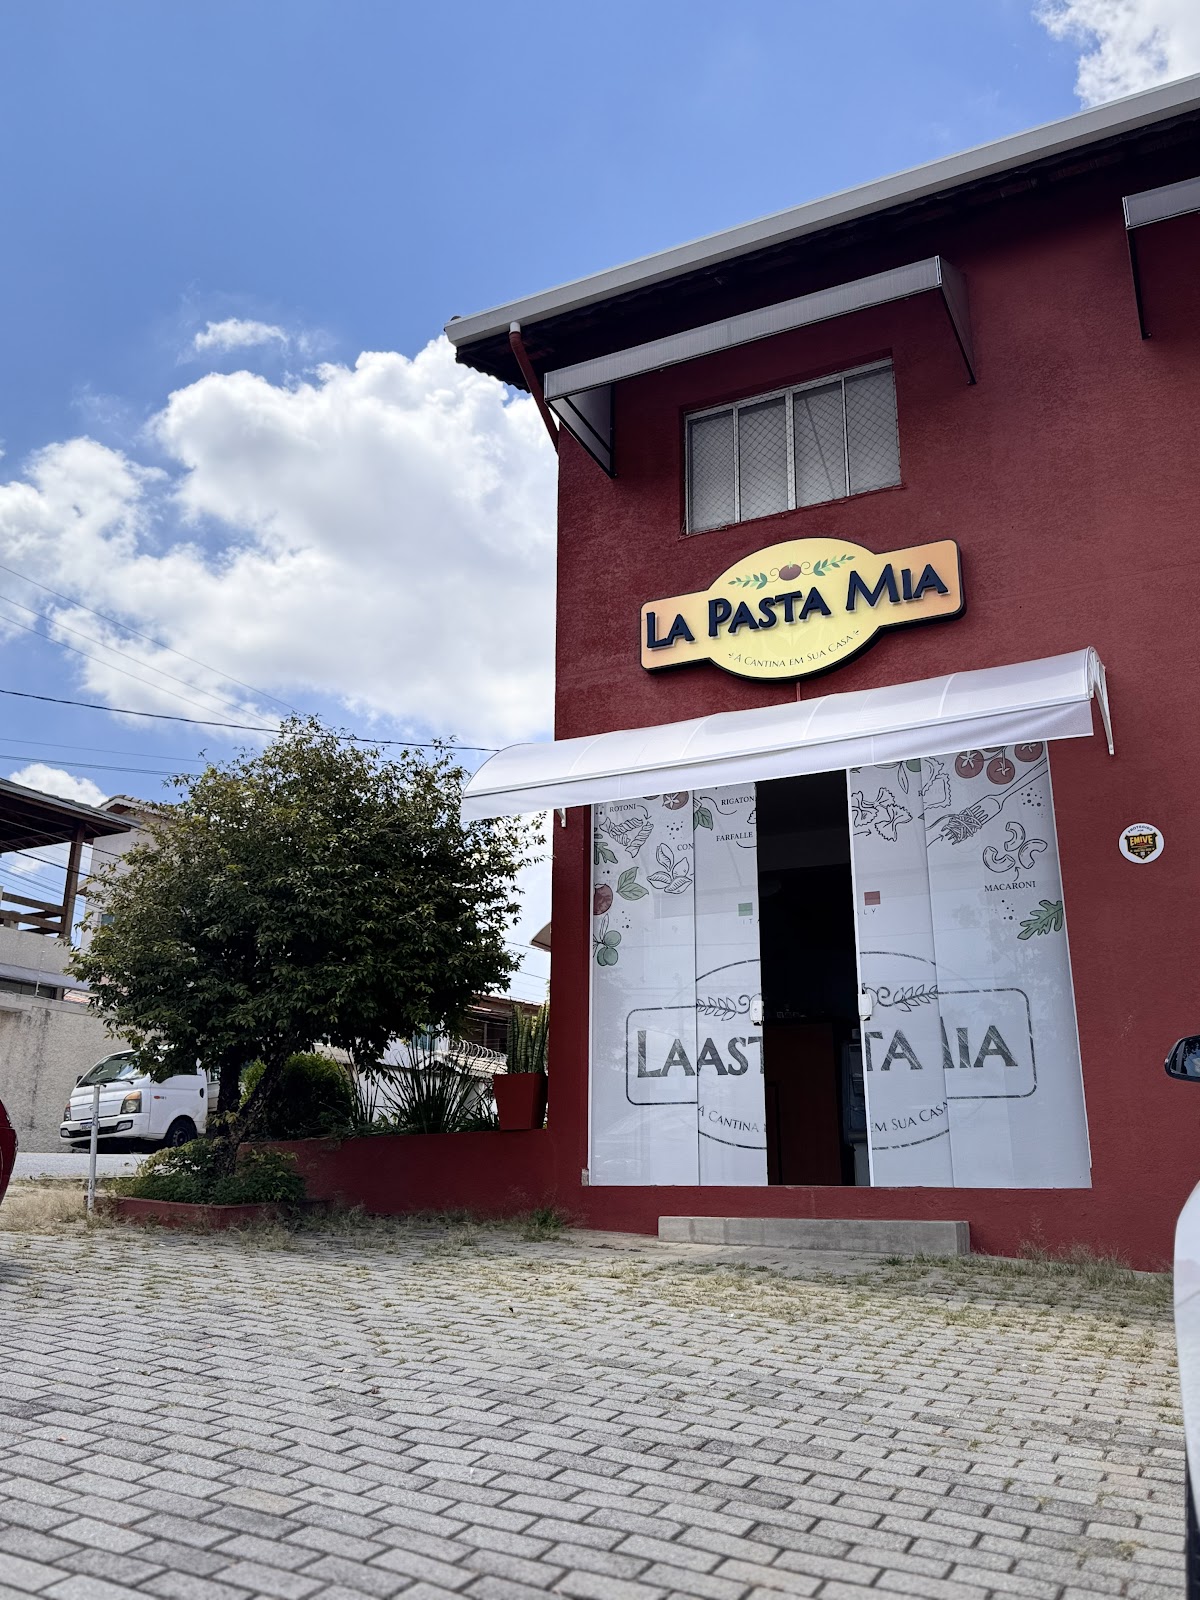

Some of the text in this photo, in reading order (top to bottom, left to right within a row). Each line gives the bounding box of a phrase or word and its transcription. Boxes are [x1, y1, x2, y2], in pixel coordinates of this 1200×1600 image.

[646, 563, 948, 649] LA PASTA MIA
[734, 635, 853, 668] A CANTINA EM SUA CASA
[609, 803, 636, 813] ROTONI
[716, 831, 754, 842] FARFALLE
[1129, 835, 1153, 846] EMIVE
[984, 880, 1036, 892] MACARONI
[637, 1030, 696, 1078] LA
[708, 1110, 759, 1133] CANTINA
[892, 1116, 917, 1130] SUA
